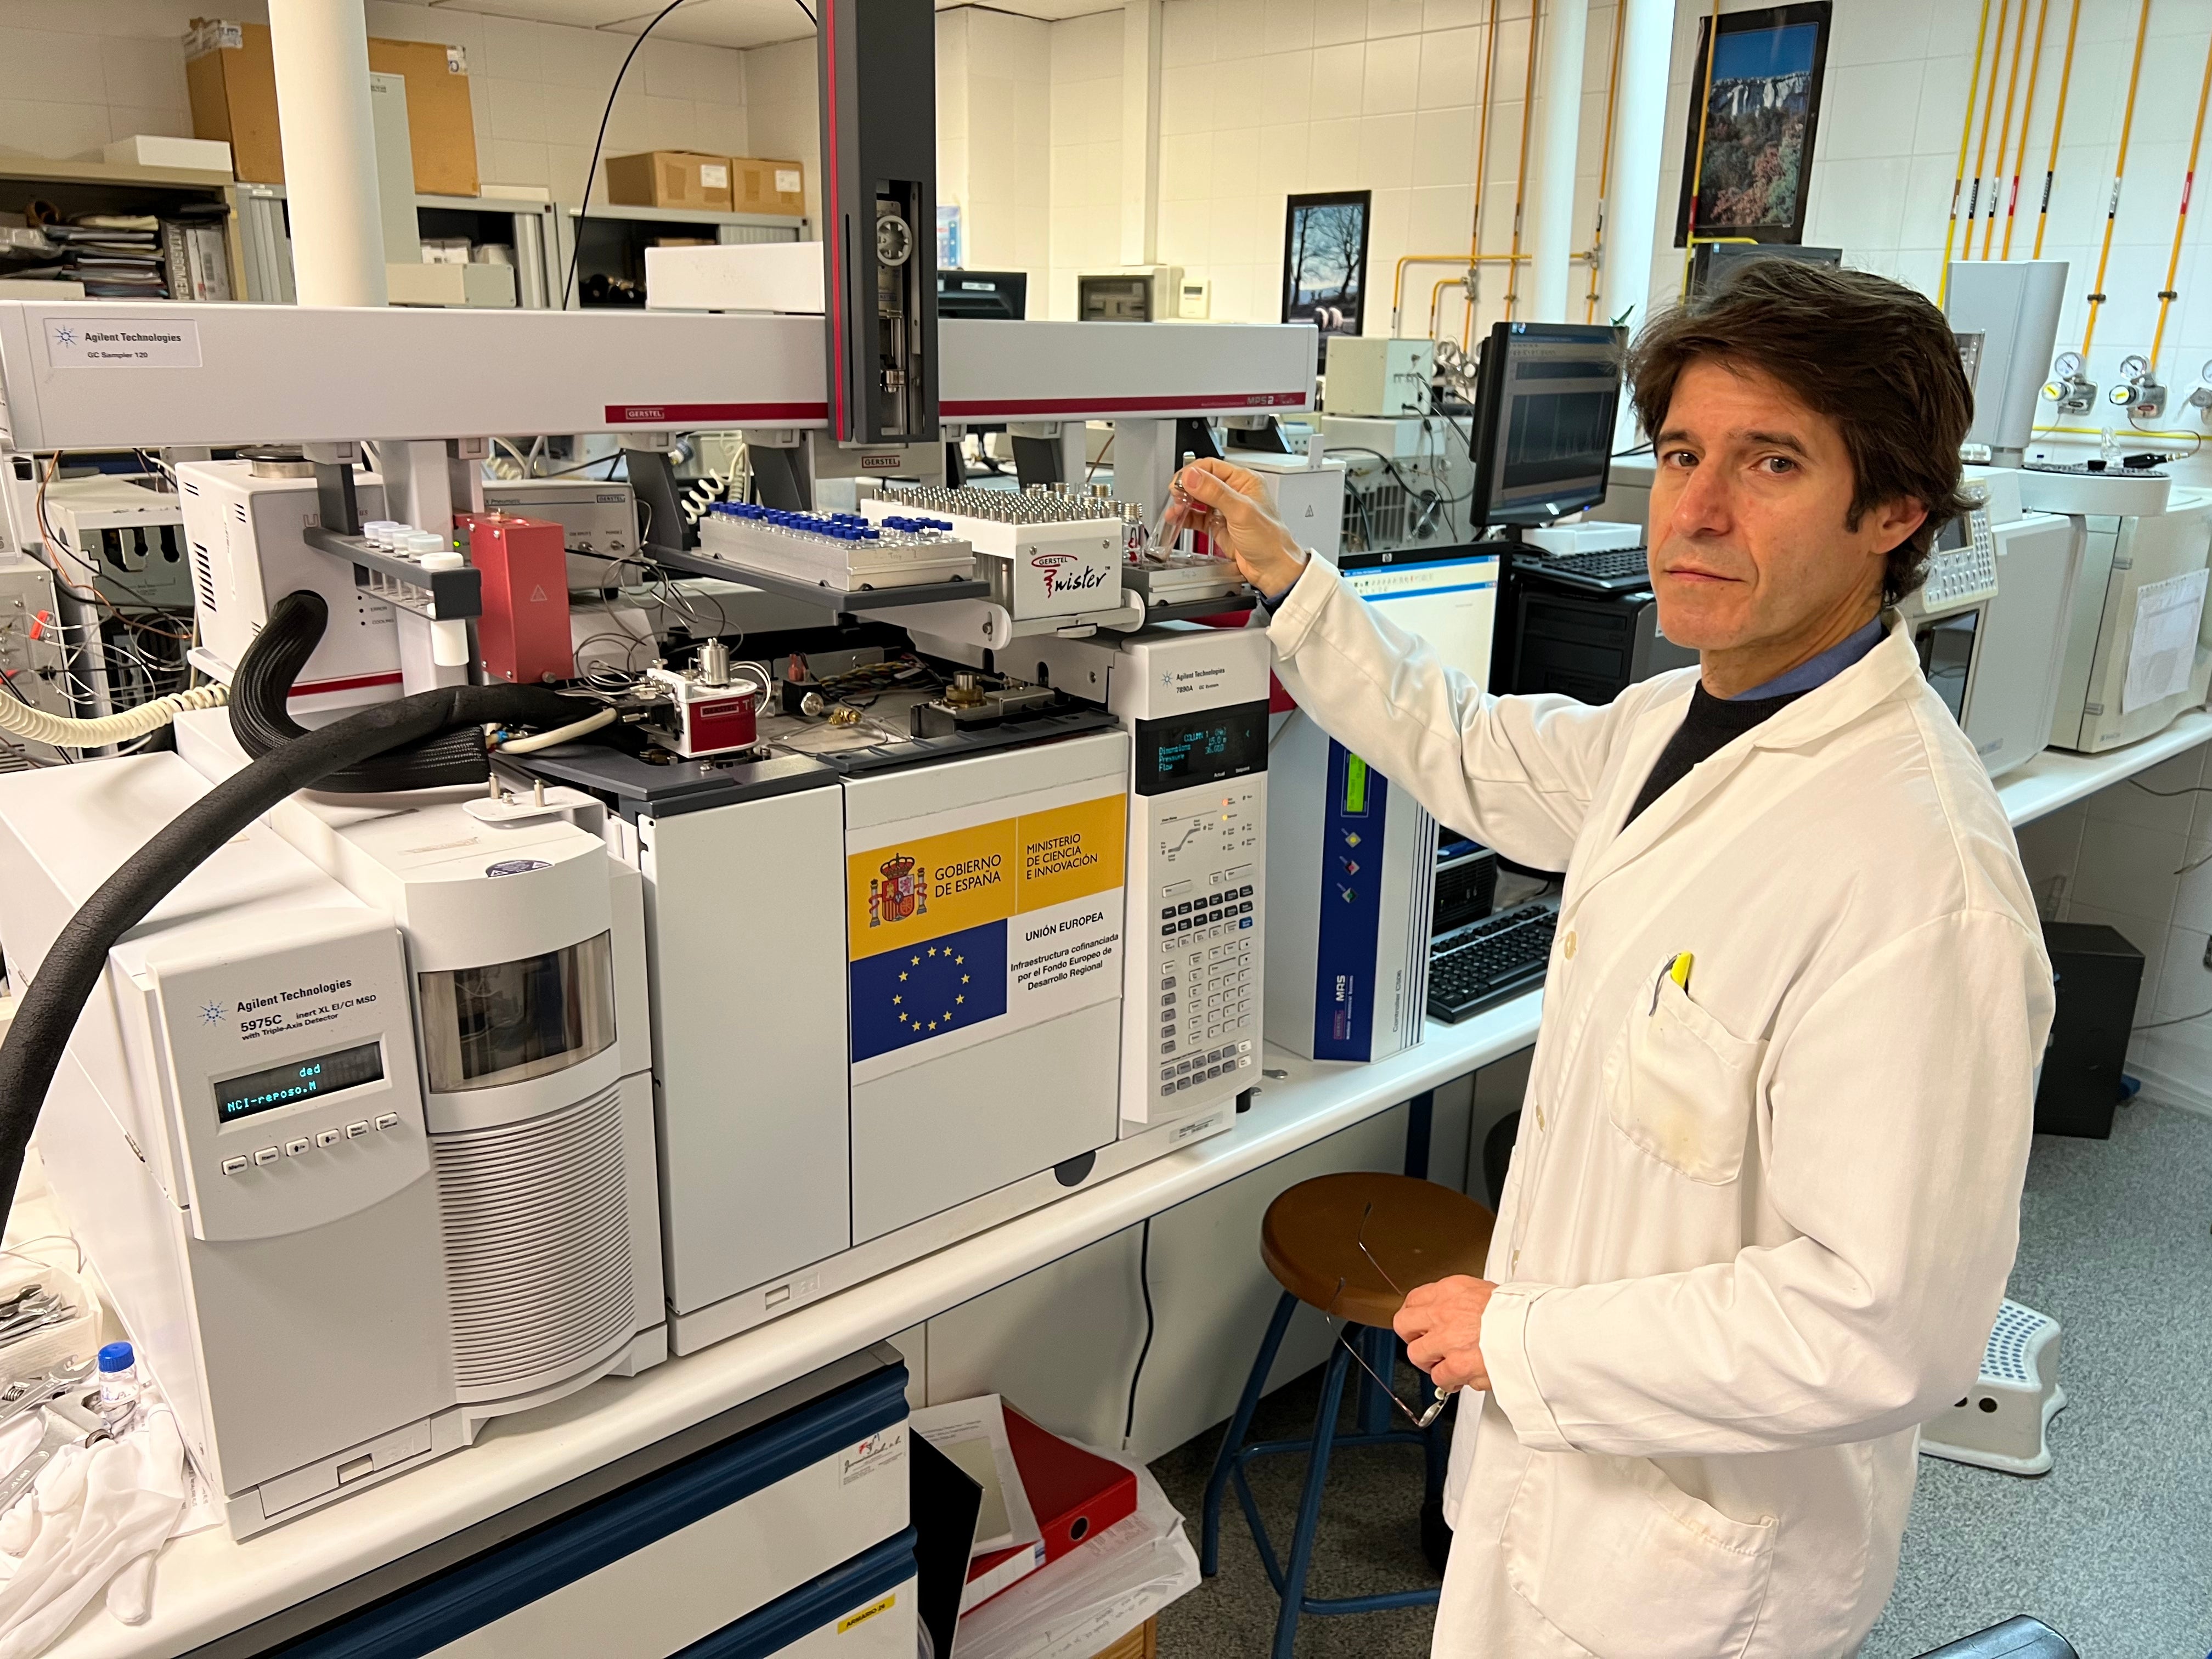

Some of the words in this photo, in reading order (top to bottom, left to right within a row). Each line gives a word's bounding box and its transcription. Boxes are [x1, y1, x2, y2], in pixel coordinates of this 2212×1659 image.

[85, 332, 119, 342] Agilent
[122, 332, 182, 343] Technologies
[1039, 557, 1068, 565] GERSTEL
[1176, 673, 1194, 681] Agilent
[1194, 668, 1224, 678] Technologies
[1176, 685, 1193, 693] 7890A
[1026, 855, 1040, 867] DE
[1042, 845, 1081, 863] CIENCIA
[1027, 833, 1081, 855] MINISTERIO
[935, 854, 1001, 881] GOBIERNO
[1026, 870, 1032, 880] E
[1035, 853, 1097, 878] INNOVACIÓN
[935, 882, 952, 898] DE
[956, 869, 1001, 893] ESPAÑA
[1025, 924, 1057, 941] UNIÓN
[1059, 911, 1104, 932] EUROPEA
[1011, 949, 1069, 972] Infraestructura
[1071, 933, 1119, 953] cofinanciada
[1018, 972, 1032, 983] por
[1034, 968, 1041, 977] el
[1043, 960, 1067, 974] Fondo
[1069, 951, 1101, 966] Europeo
[1103, 946, 1112, 956] de
[1028, 972, 1068, 990] Desarrollo
[1070, 960, 1103, 978] Regional
[1335, 974, 1346, 1002] MAS
[237, 995, 279, 1012] Agilent
[279, 979, 352, 1002] Technologies
[240, 1014, 283, 1032] 5975C
[296, 1010, 317, 1019] inert
[318, 1006, 330, 1014] XL
[331, 1000, 354, 1011] EI/CI
[356, 994, 377, 1005] MSD
[241, 1031, 261, 1041] with
[262, 1022, 303, 1035] Triple-Axis
[304, 1013, 338, 1025] Detector
[299, 1063, 321, 1077] ded
[227, 1080, 317, 1112] NCI-reposo.M
